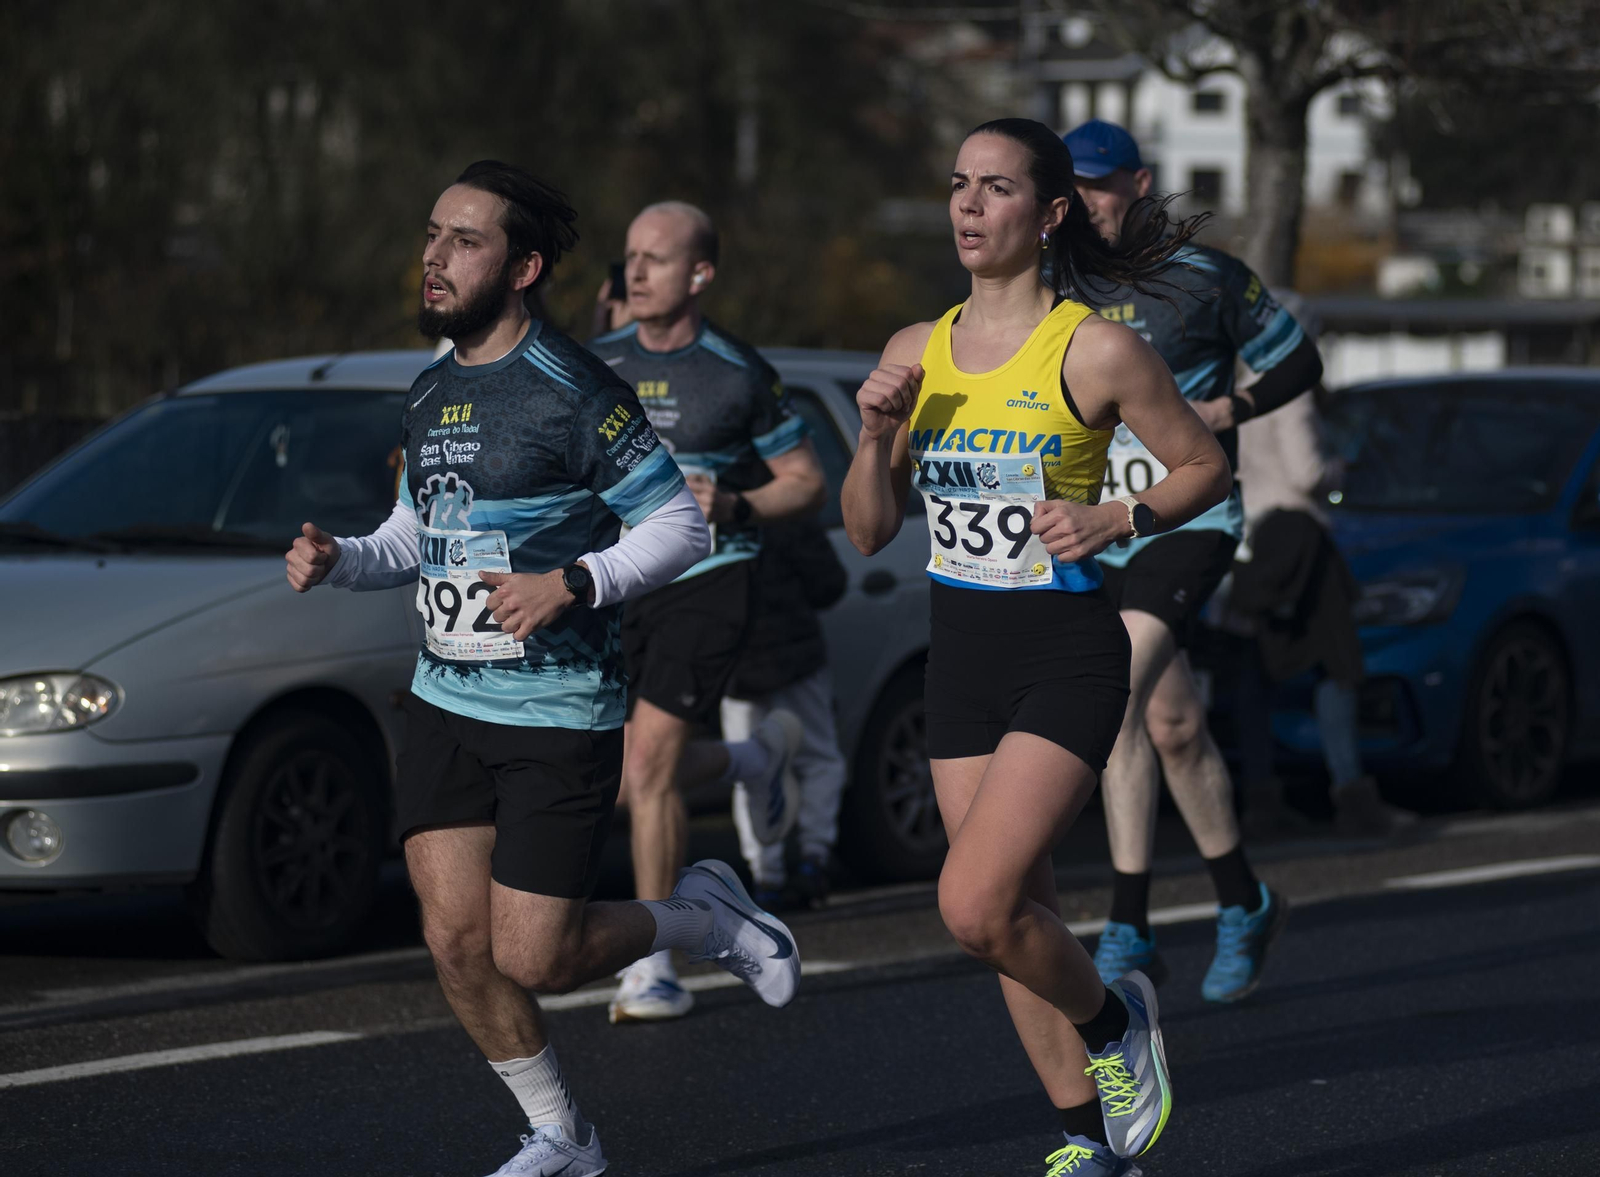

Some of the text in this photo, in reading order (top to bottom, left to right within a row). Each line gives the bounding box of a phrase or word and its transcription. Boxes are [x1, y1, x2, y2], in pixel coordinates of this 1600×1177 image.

[440, 403, 473, 425] XXII
[1006, 399, 1050, 411] amura
[598, 404, 632, 442] XXII
[420, 439, 481, 457] San Cibrao
[909, 428, 1062, 458] MIACTIVA
[1042, 460, 1061, 468] TIVA
[930, 494, 1033, 560] 339
